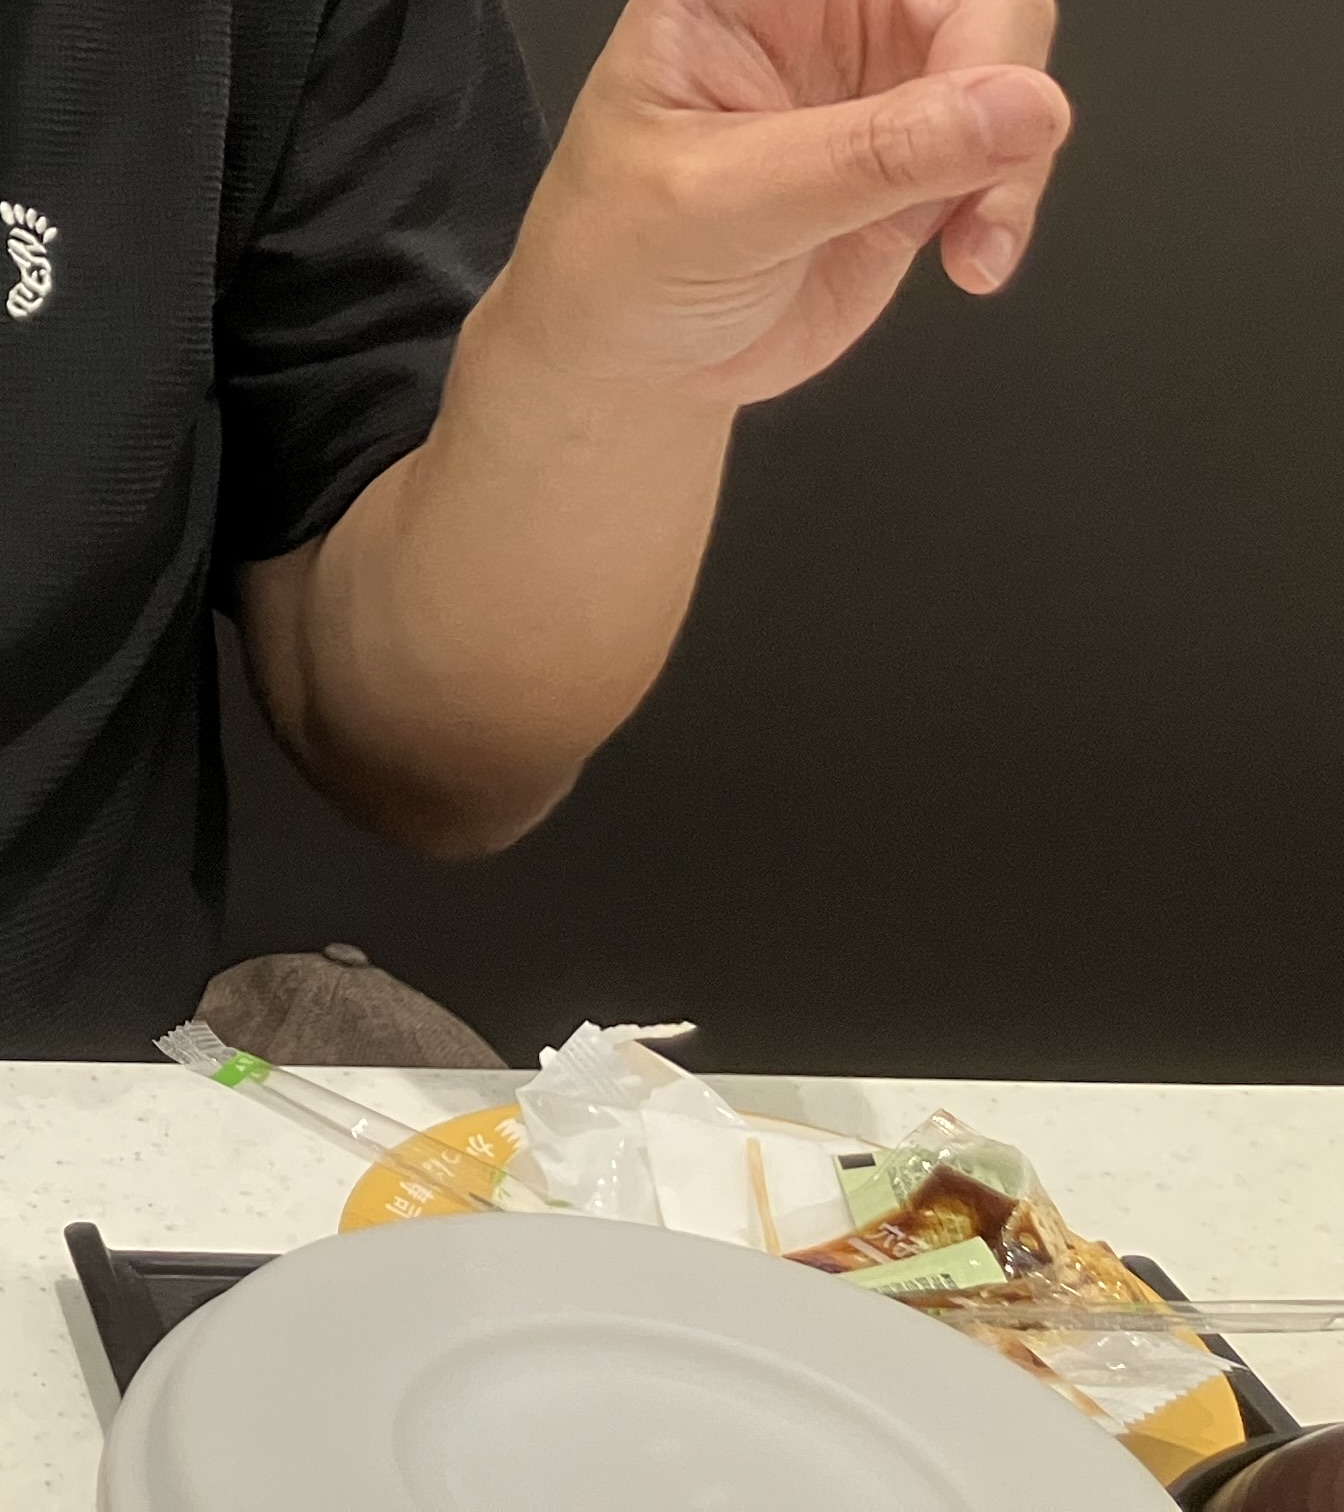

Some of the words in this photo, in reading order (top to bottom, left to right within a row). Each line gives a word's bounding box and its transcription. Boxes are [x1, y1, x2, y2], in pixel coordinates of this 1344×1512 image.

[384, 1133, 495, 1219] かっぱ寿司
